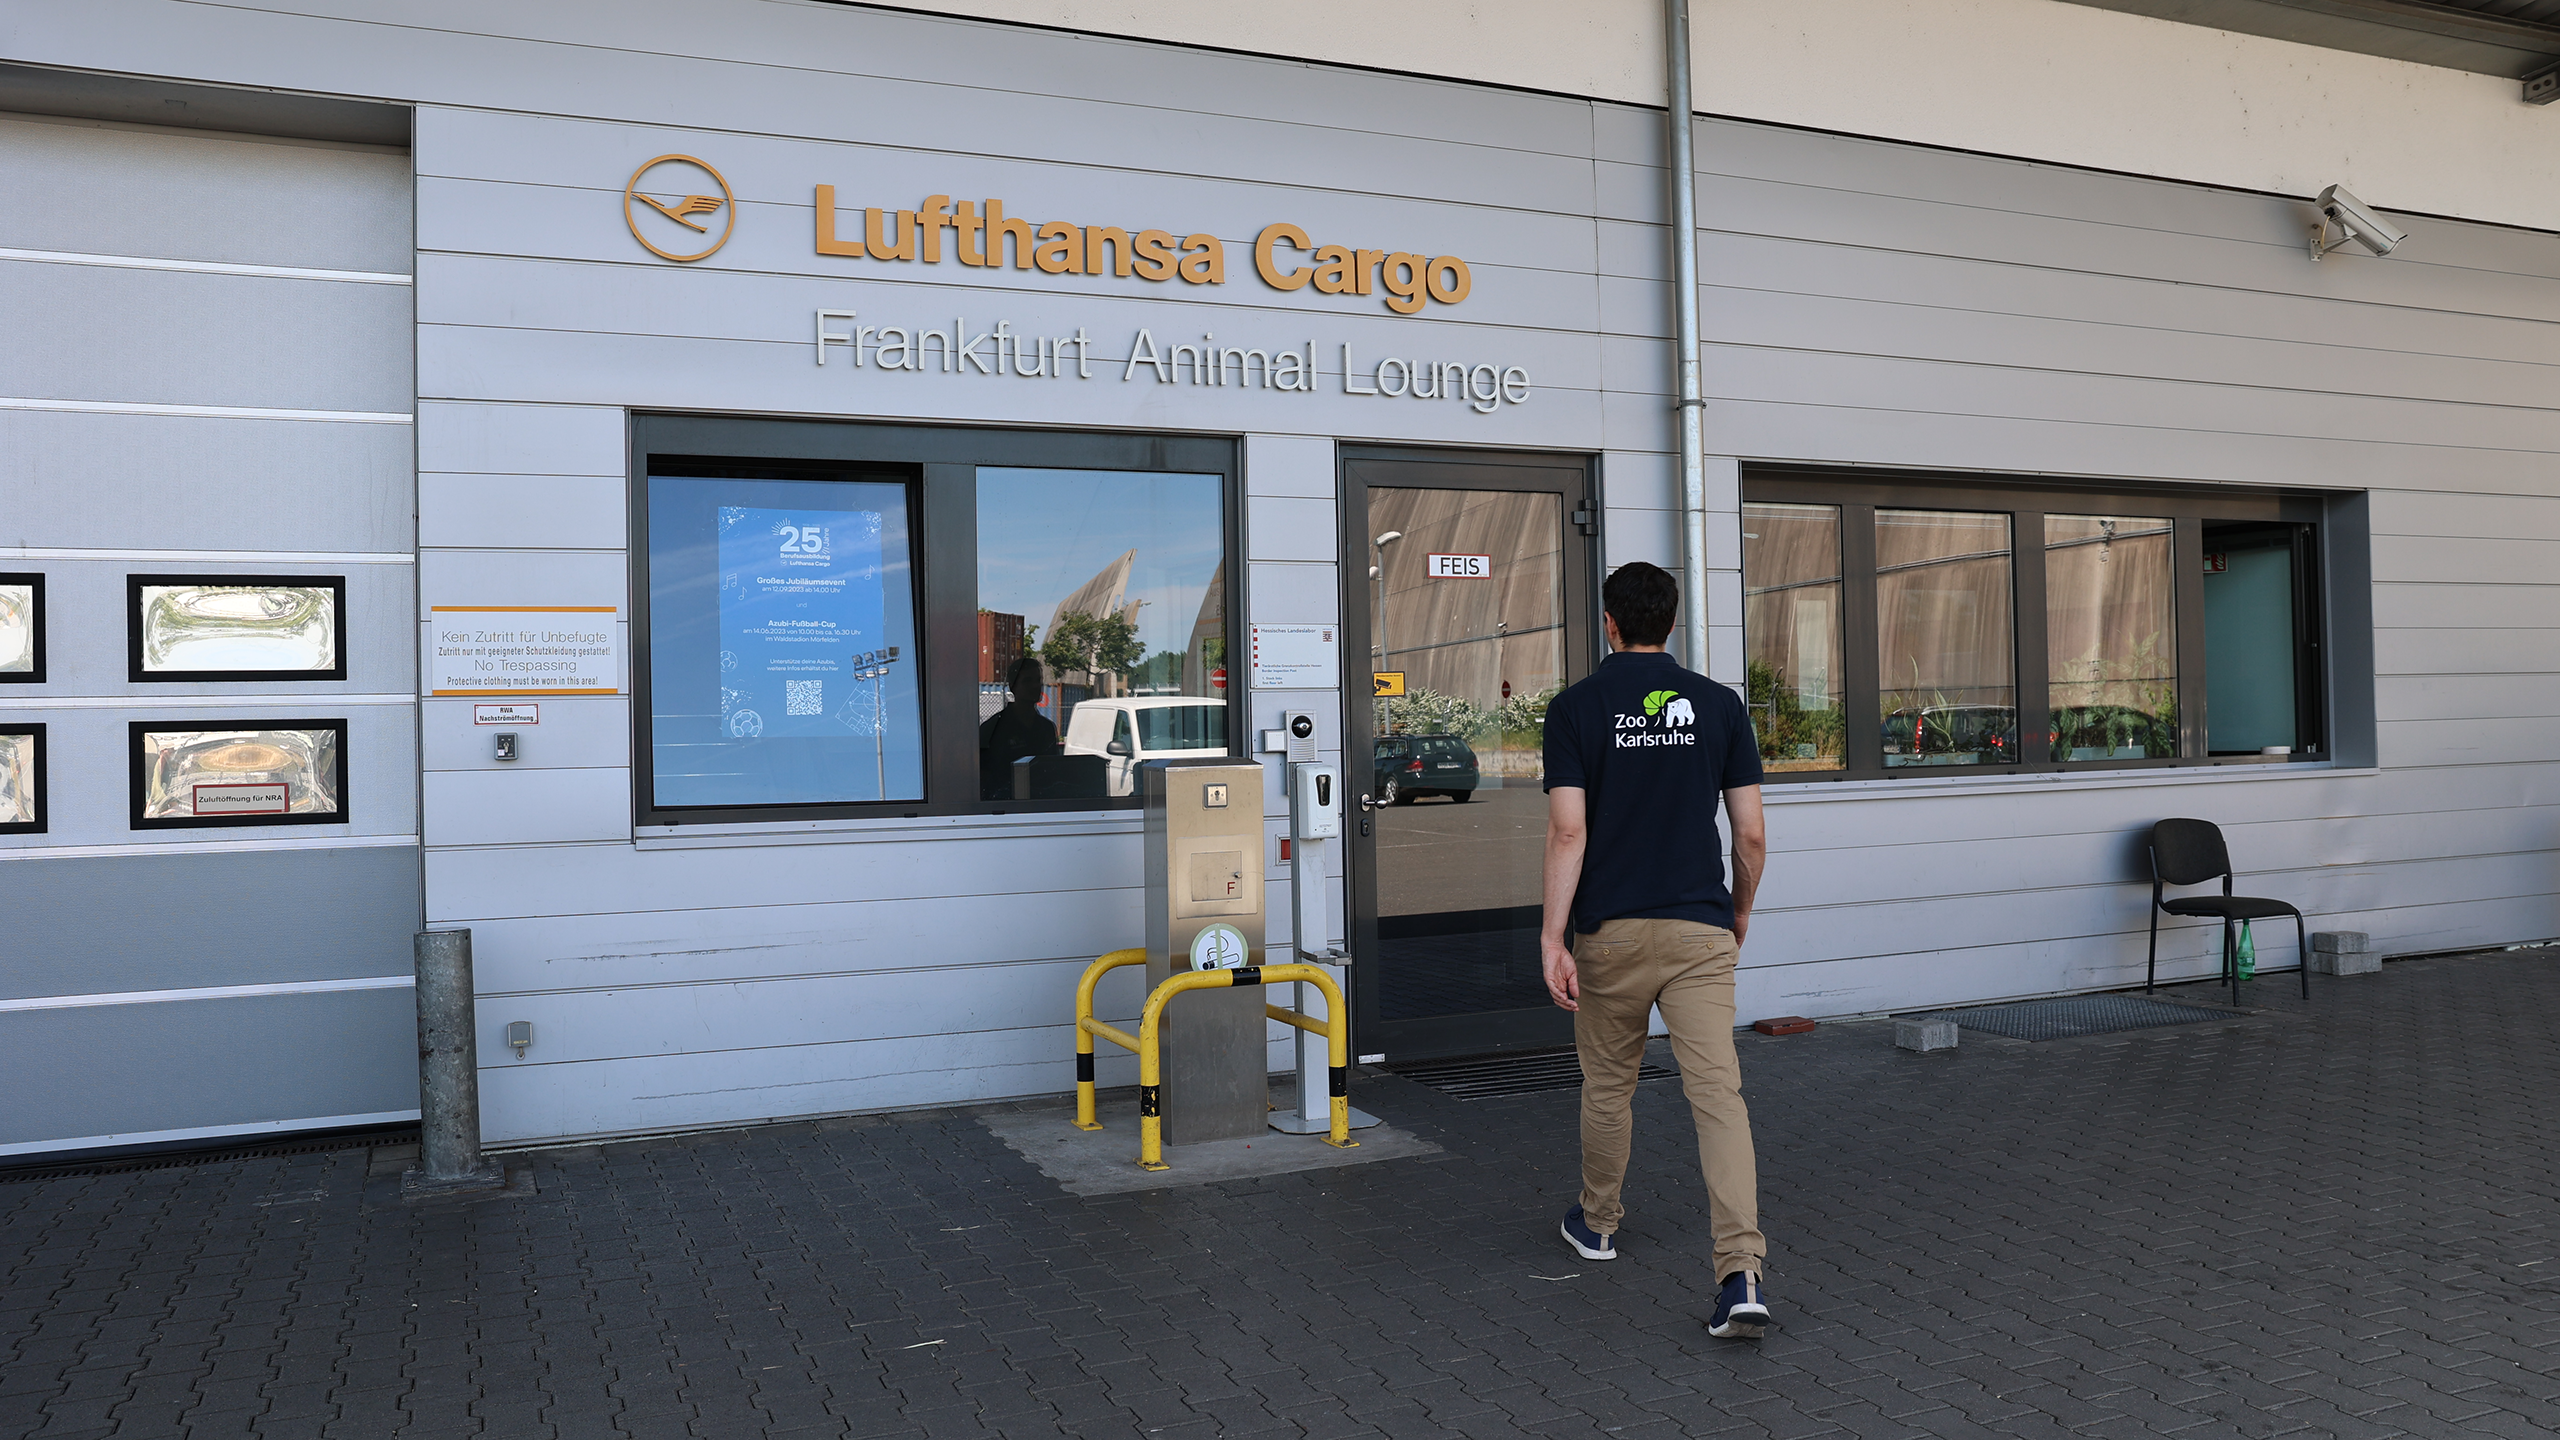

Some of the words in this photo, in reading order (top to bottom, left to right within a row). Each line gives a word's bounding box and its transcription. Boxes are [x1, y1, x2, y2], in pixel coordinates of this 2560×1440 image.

[814, 183, 1226, 286] Lufthansa
[1254, 222, 1473, 315] Cargo
[814, 308, 1093, 379] Frankfurt
[1123, 328, 1319, 392] Animal
[1341, 341, 1532, 414] Lounge
[779, 525, 823, 553] 25
[780, 552, 831, 561] Berufsausbildung
[1440, 557, 1480, 575] FEIS
[756, 576, 785, 585] Großes
[786, 577, 846, 586] Jubiläumsevent
[768, 620, 836, 628] Azubi-Fußball-Cup
[441, 631, 470, 643] Kein
[475, 631, 515, 643] Zutritt
[519, 631, 537, 643] für
[541, 631, 608, 645] Unbefugte
[438, 646, 461, 656] Zutritt
[462, 648, 474, 656] nur
[475, 646, 486, 656] mit
[488, 646, 524, 658] geeigneter
[526, 646, 577, 658] Schutzkleidung
[578, 646, 611, 658] gestattet!
[474, 660, 494, 672] No
[499, 659, 578, 673] Trespassing
[447, 676, 482, 686] Protective
[484, 676, 512, 688] clothing
[512, 677, 530, 686] must
[531, 676, 540, 686] be
[558, 676, 566, 686] in
[566, 676, 580, 686] this
[581, 676, 598, 686] area!
[1614, 713, 1647, 729] Zoo
[1615, 729, 1696, 748] Karlsruhe
[198, 796, 251, 804] Zuluftöffnung
[1227, 881, 1236, 895] F
